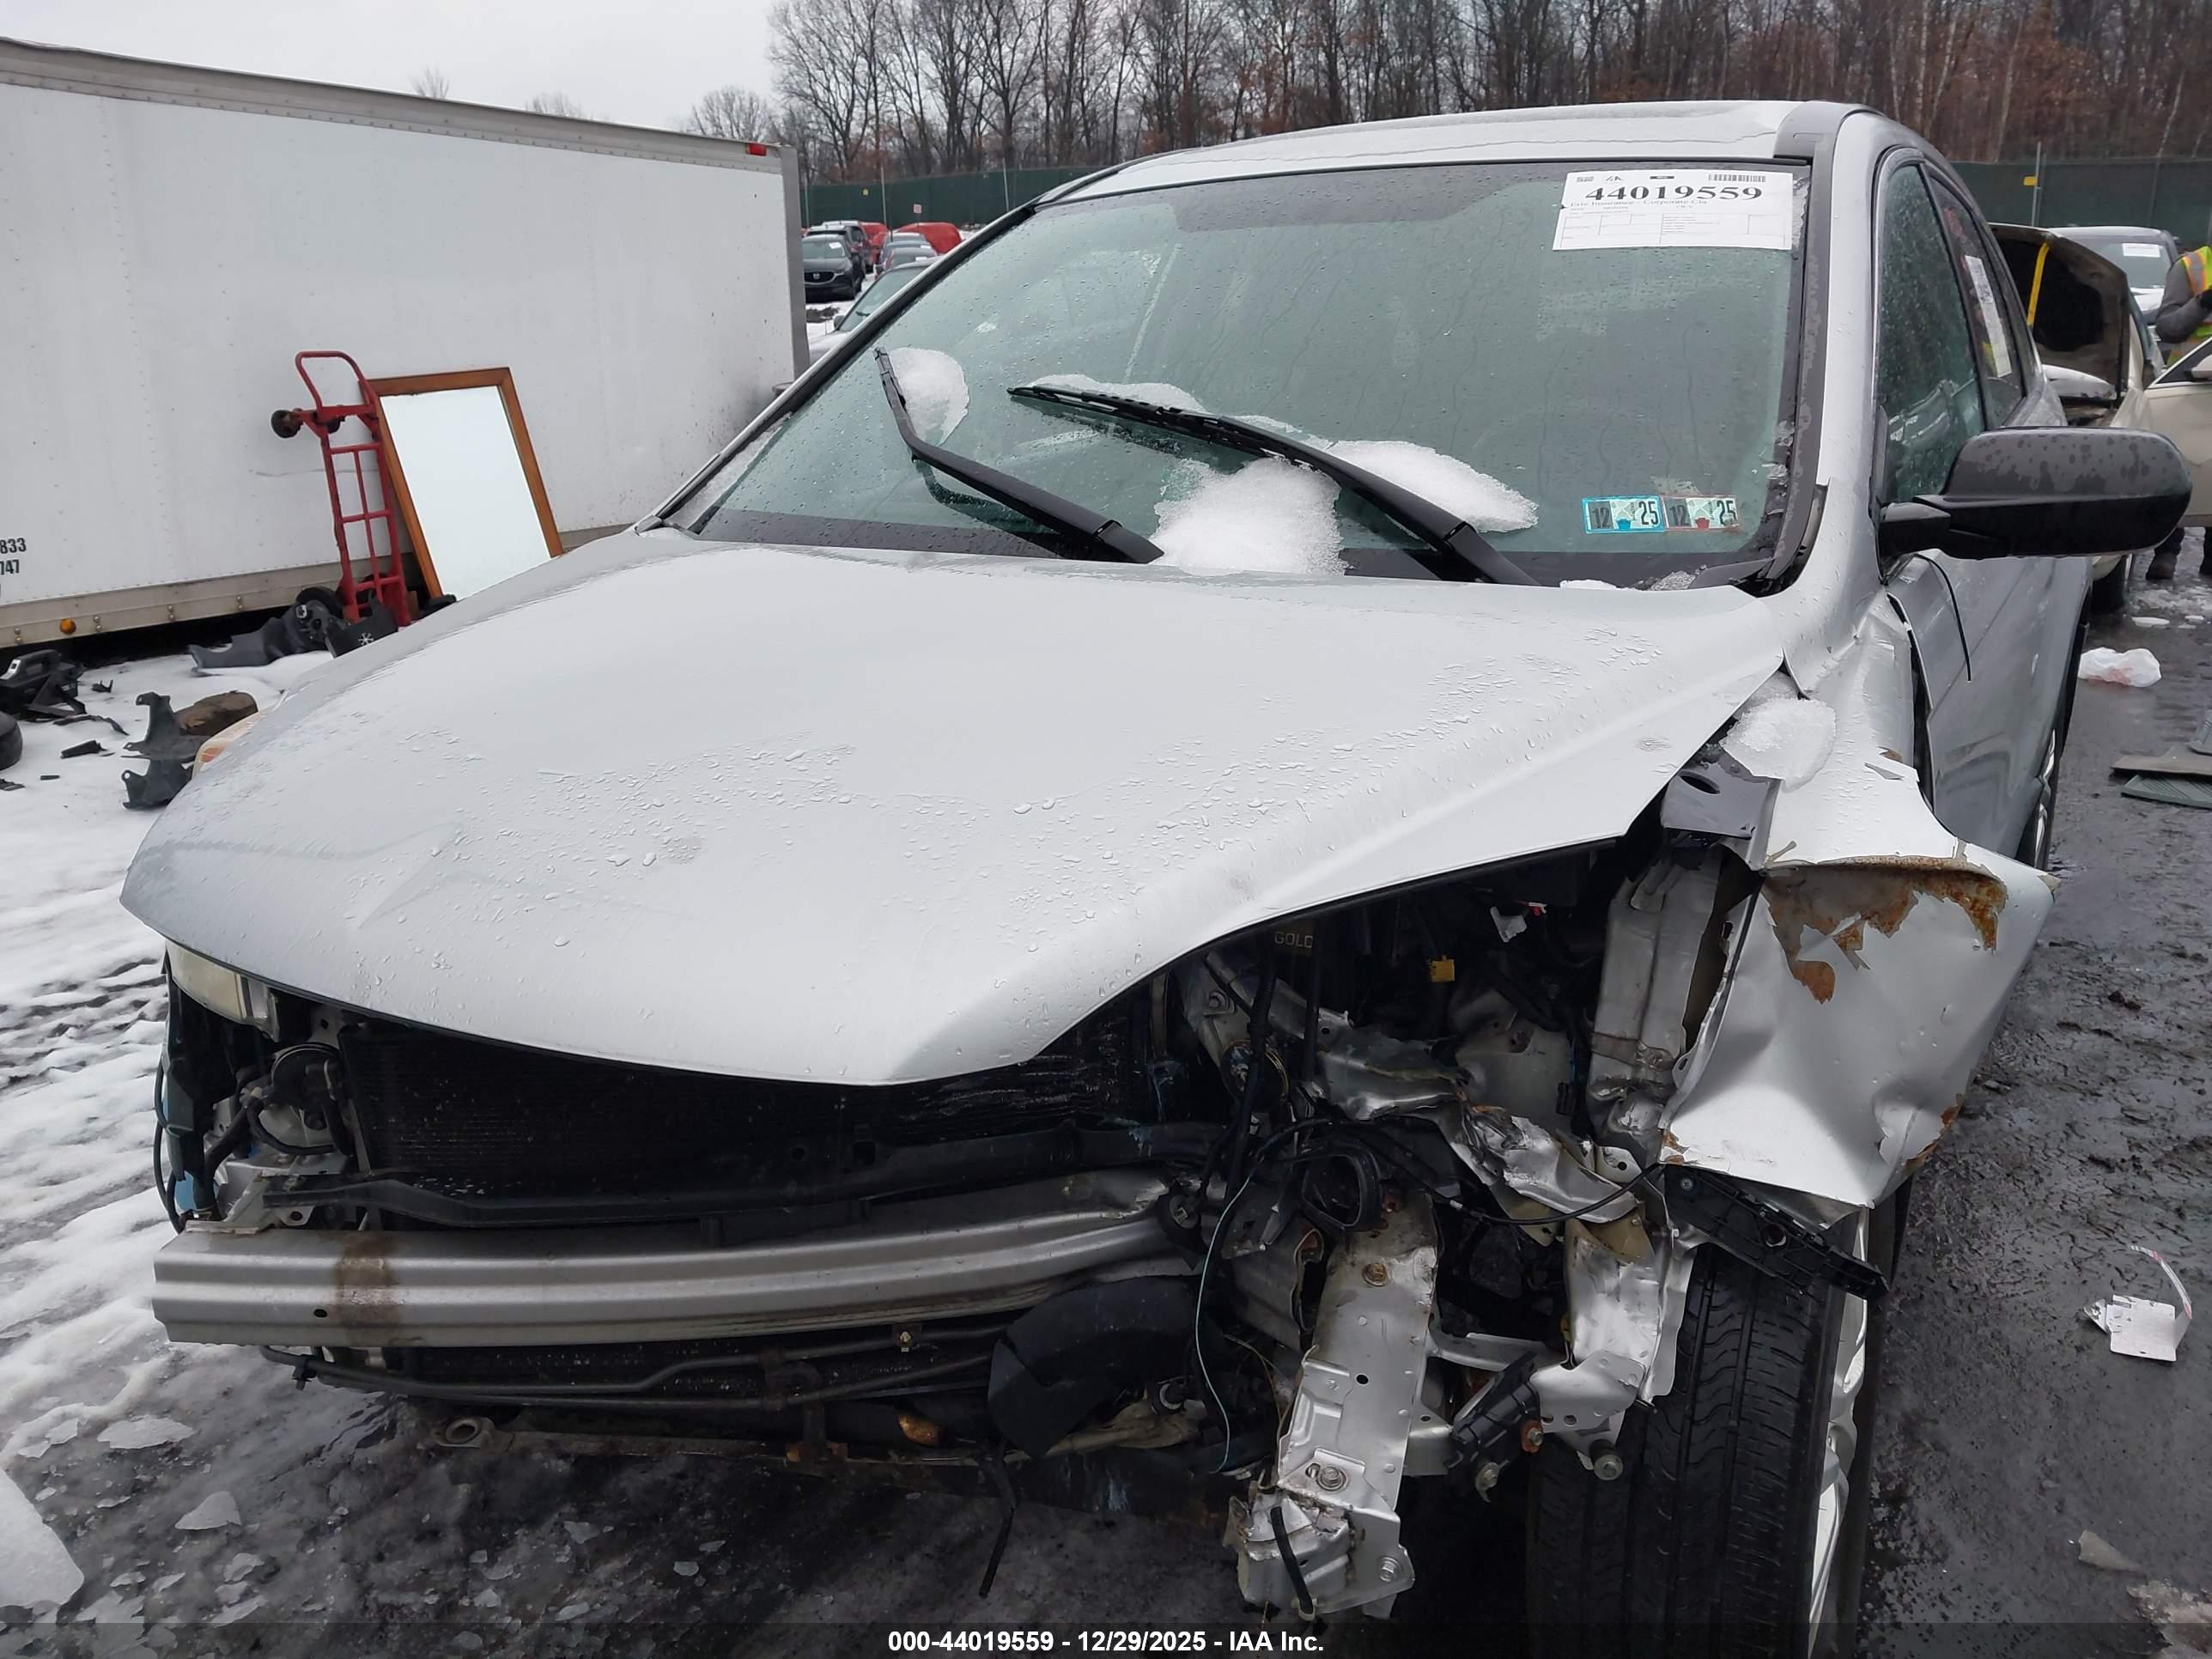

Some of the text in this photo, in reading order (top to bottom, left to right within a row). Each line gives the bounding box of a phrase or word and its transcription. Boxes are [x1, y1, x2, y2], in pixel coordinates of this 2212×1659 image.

[1586, 185, 1763, 201] 44019559
[1638, 501, 1659, 526] 25
[1717, 500, 1736, 526] 25
[0, 538, 27, 554] 833
